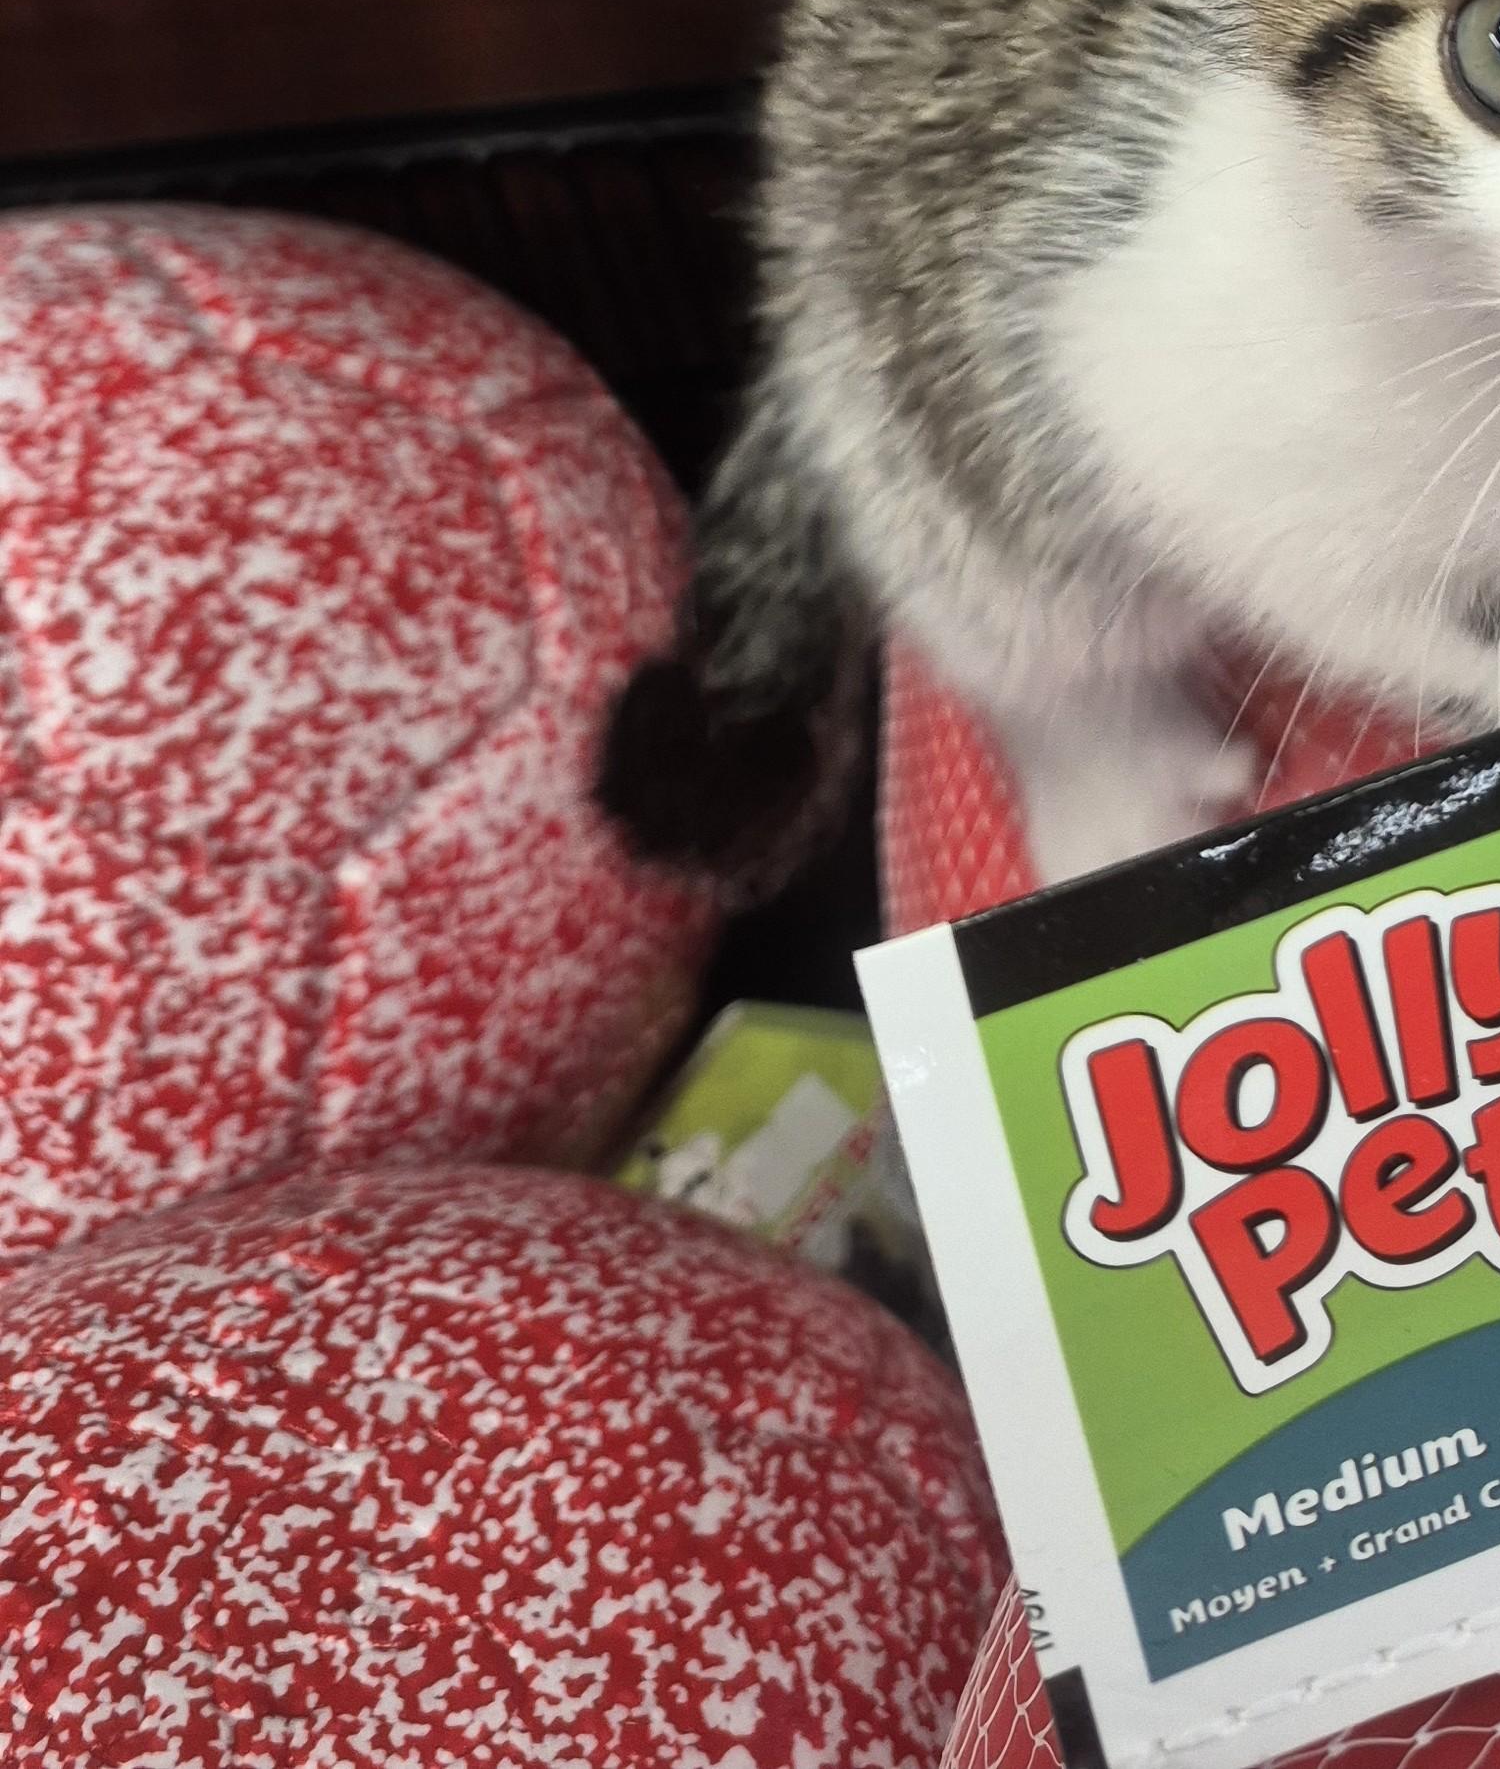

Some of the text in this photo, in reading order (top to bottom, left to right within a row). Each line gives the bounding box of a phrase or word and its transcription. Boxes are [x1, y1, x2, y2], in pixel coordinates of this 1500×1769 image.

[1219, 1426, 1489, 1553] Medium
[1168, 1565, 1309, 1635] Moyen
[1348, 1493, 1472, 1563] Grand
